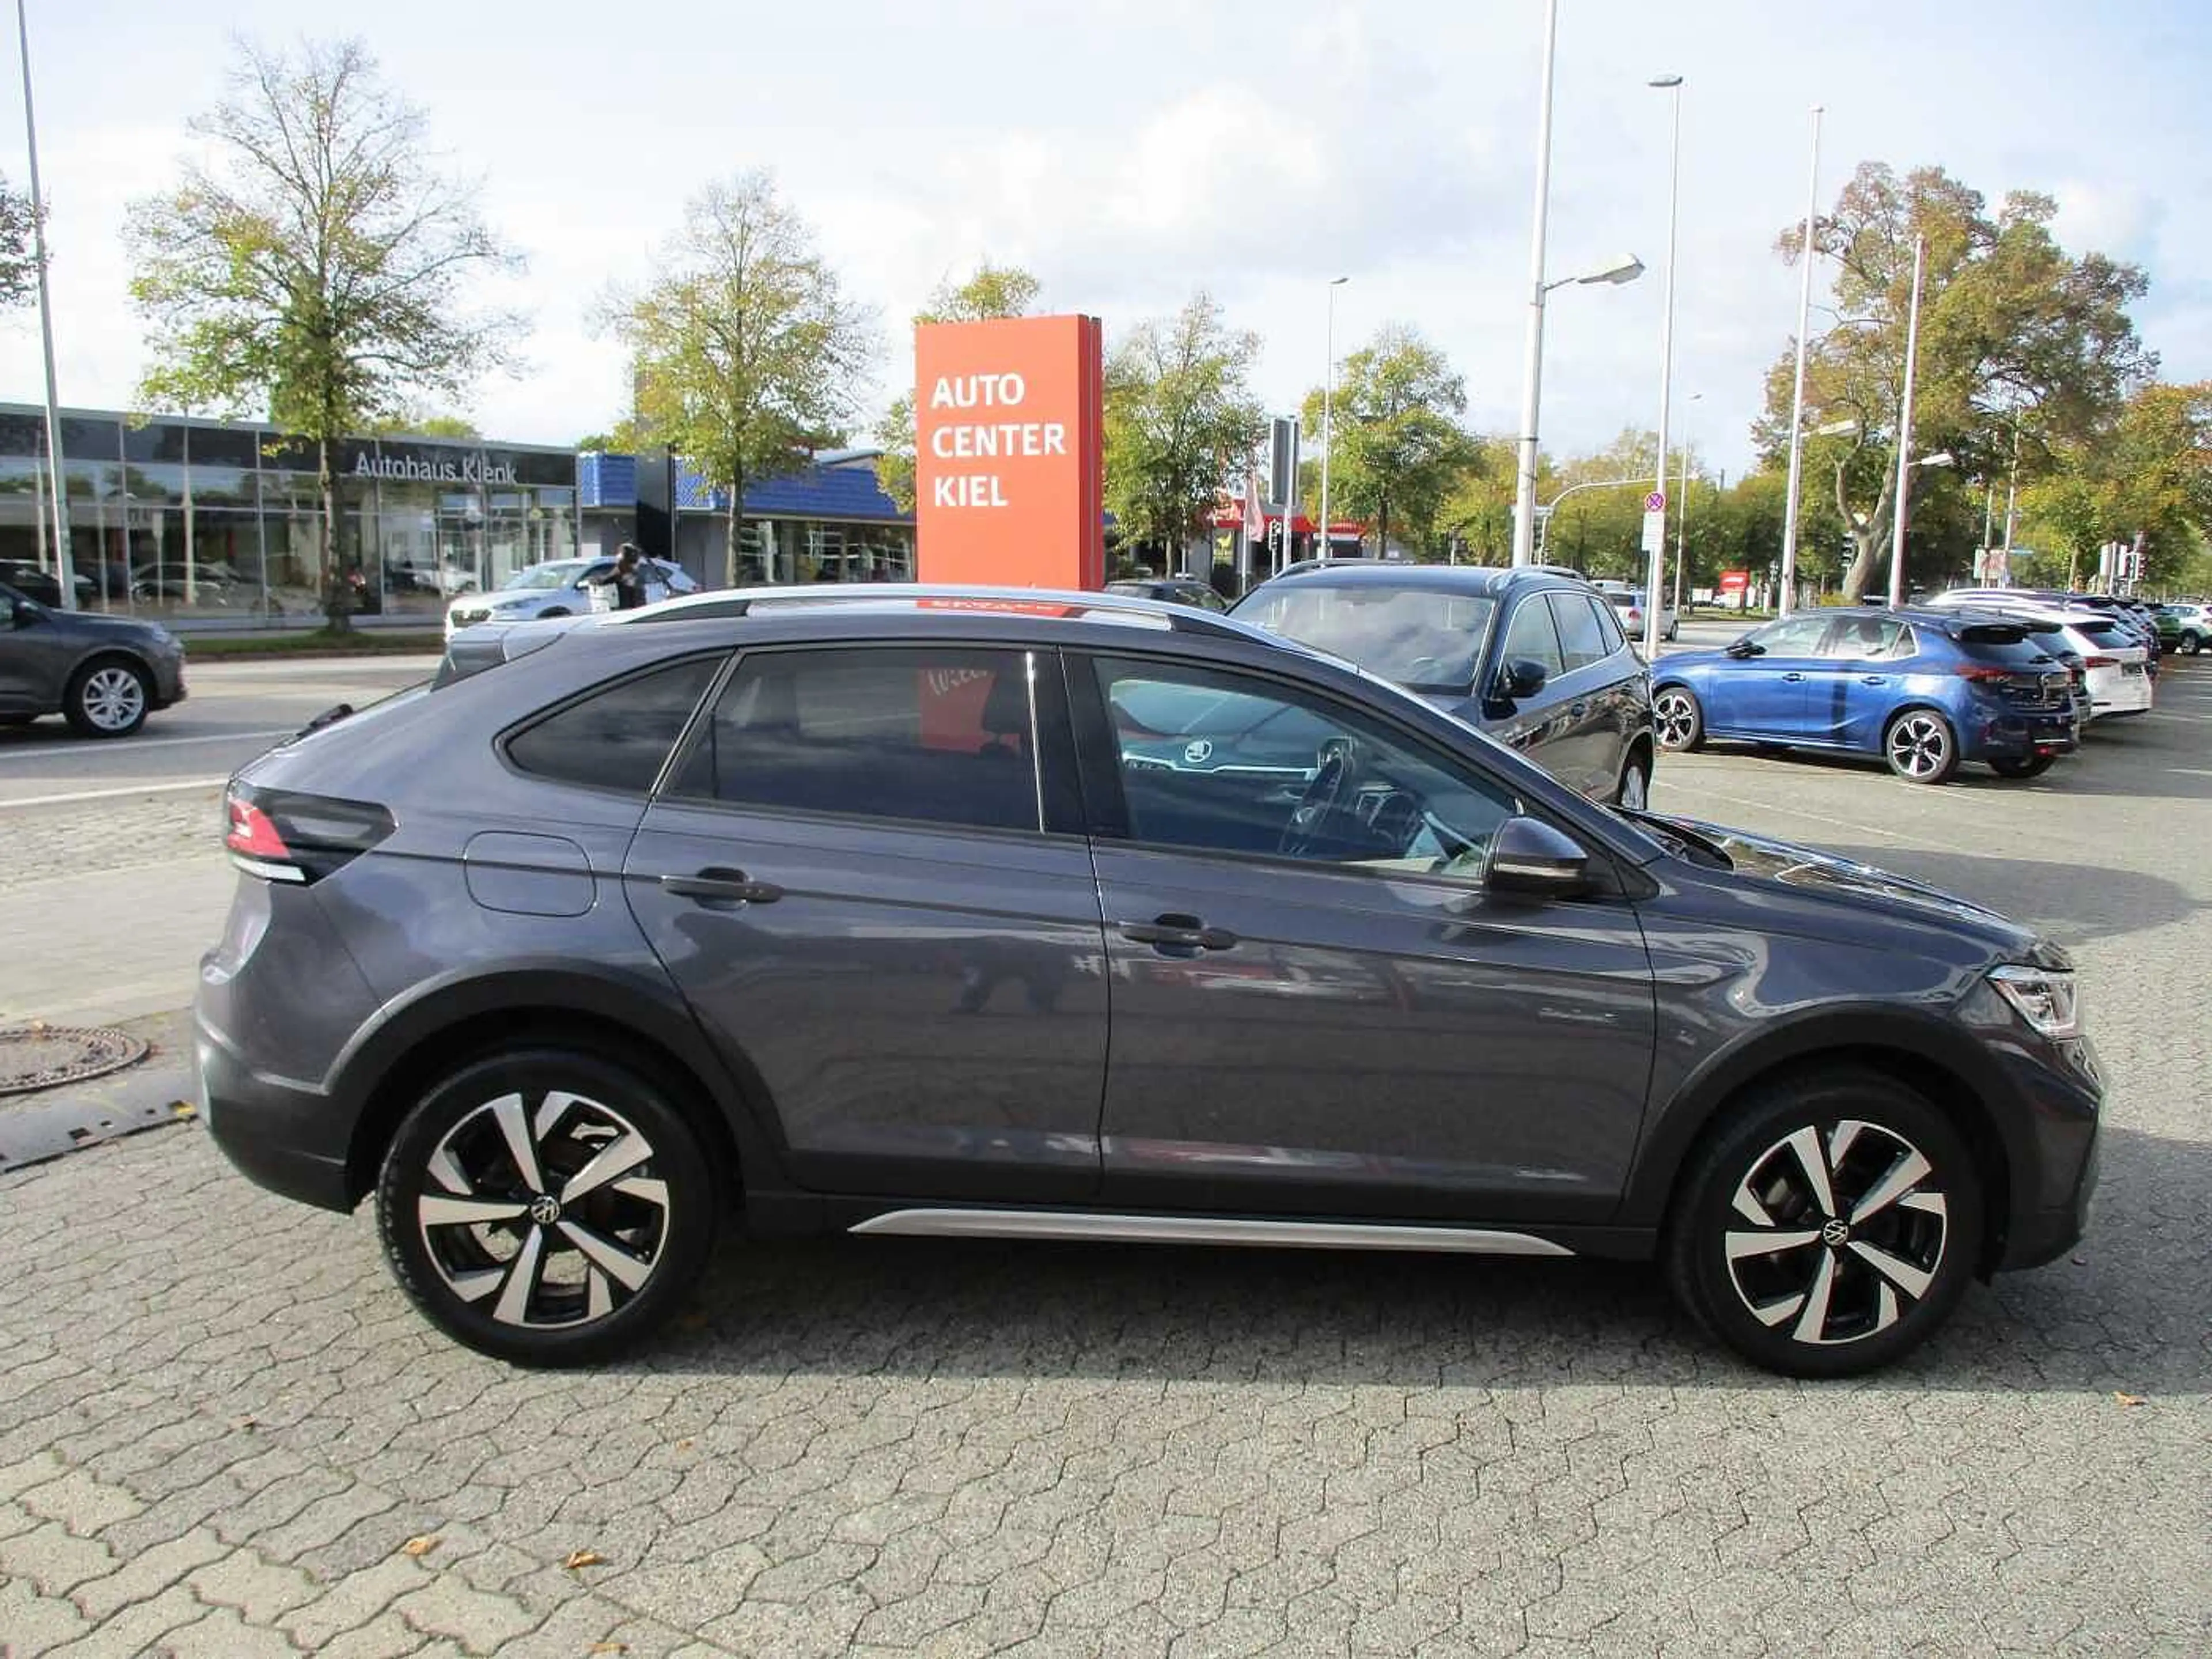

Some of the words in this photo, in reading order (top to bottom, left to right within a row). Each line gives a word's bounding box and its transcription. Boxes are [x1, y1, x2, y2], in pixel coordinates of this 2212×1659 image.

[931, 373, 1025, 409] AUTO
[933, 422, 1066, 459] CENTER
[355, 451, 456, 482] Autohaus
[463, 454, 517, 485] Klenk
[934, 475, 1010, 507] KIEL
